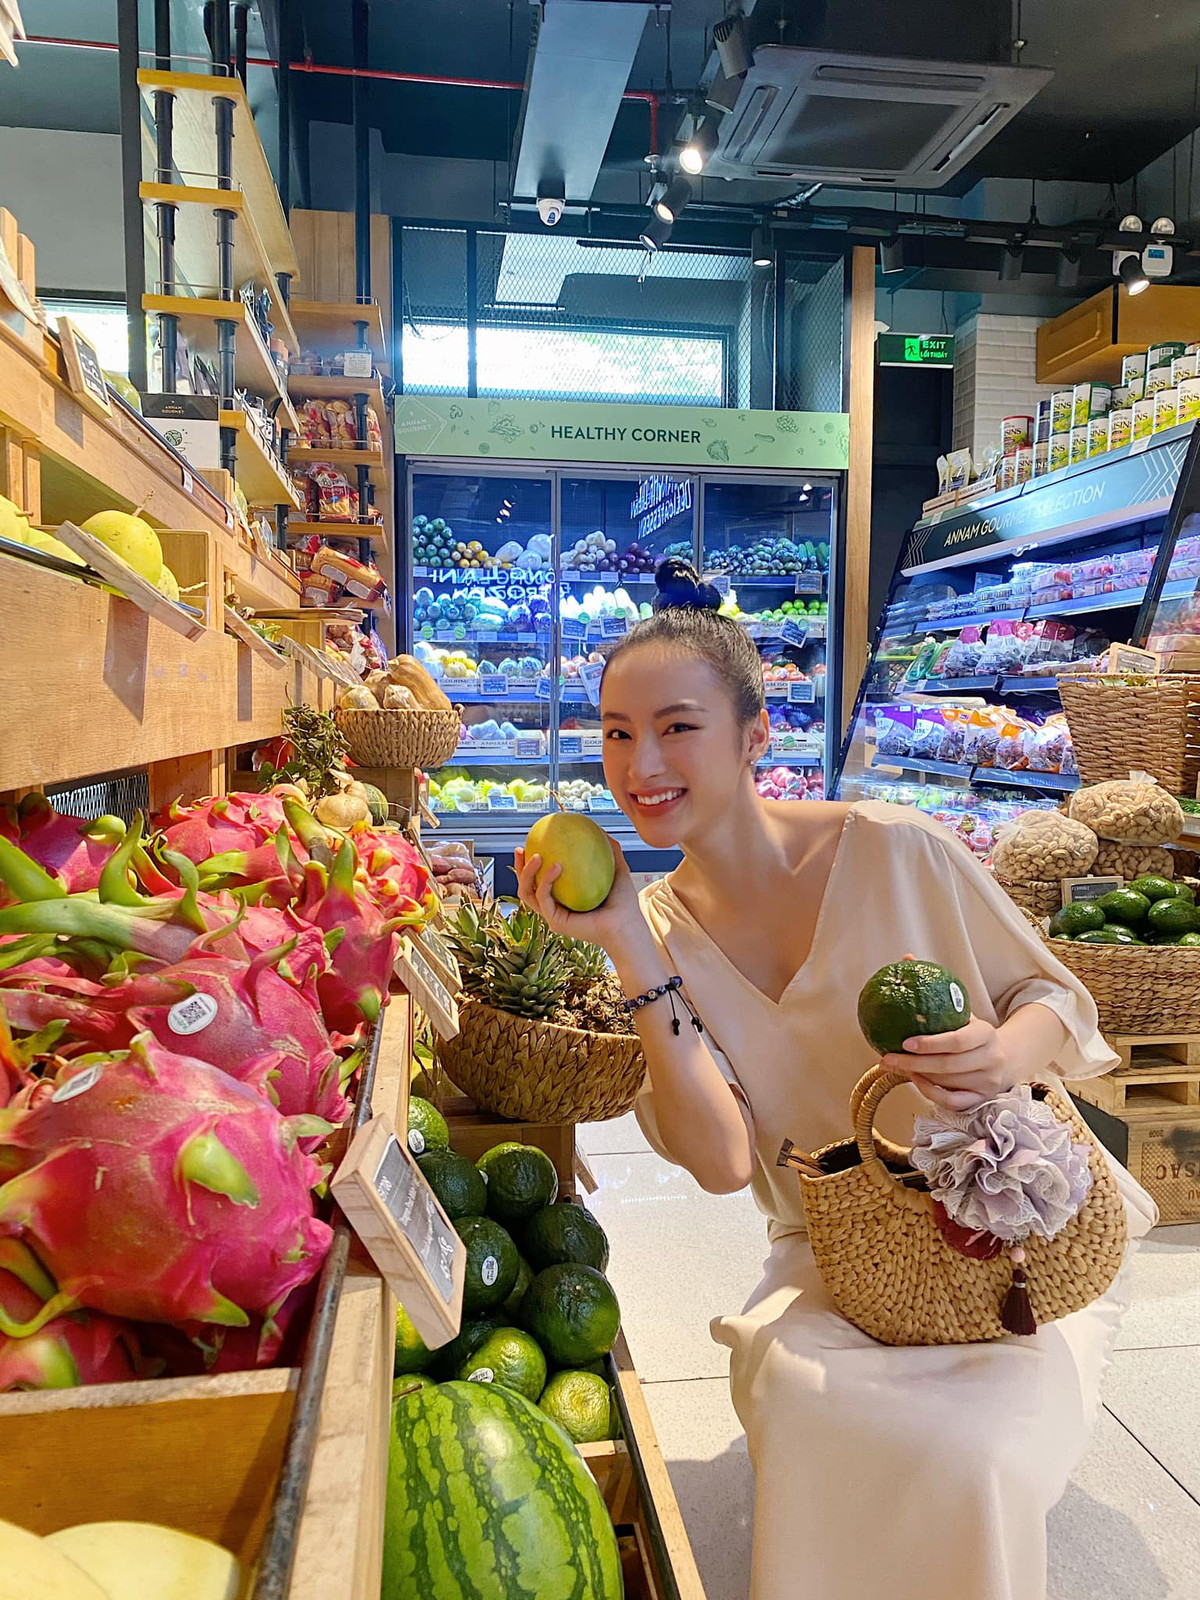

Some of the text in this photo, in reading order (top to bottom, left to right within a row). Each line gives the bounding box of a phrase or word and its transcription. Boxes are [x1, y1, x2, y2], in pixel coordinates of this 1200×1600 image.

[922, 340, 946, 349] EXIT
[551, 425, 701, 443] HEALTHY CORNER
[944, 481, 1106, 547] ANNAM GOURMET SELECTION
